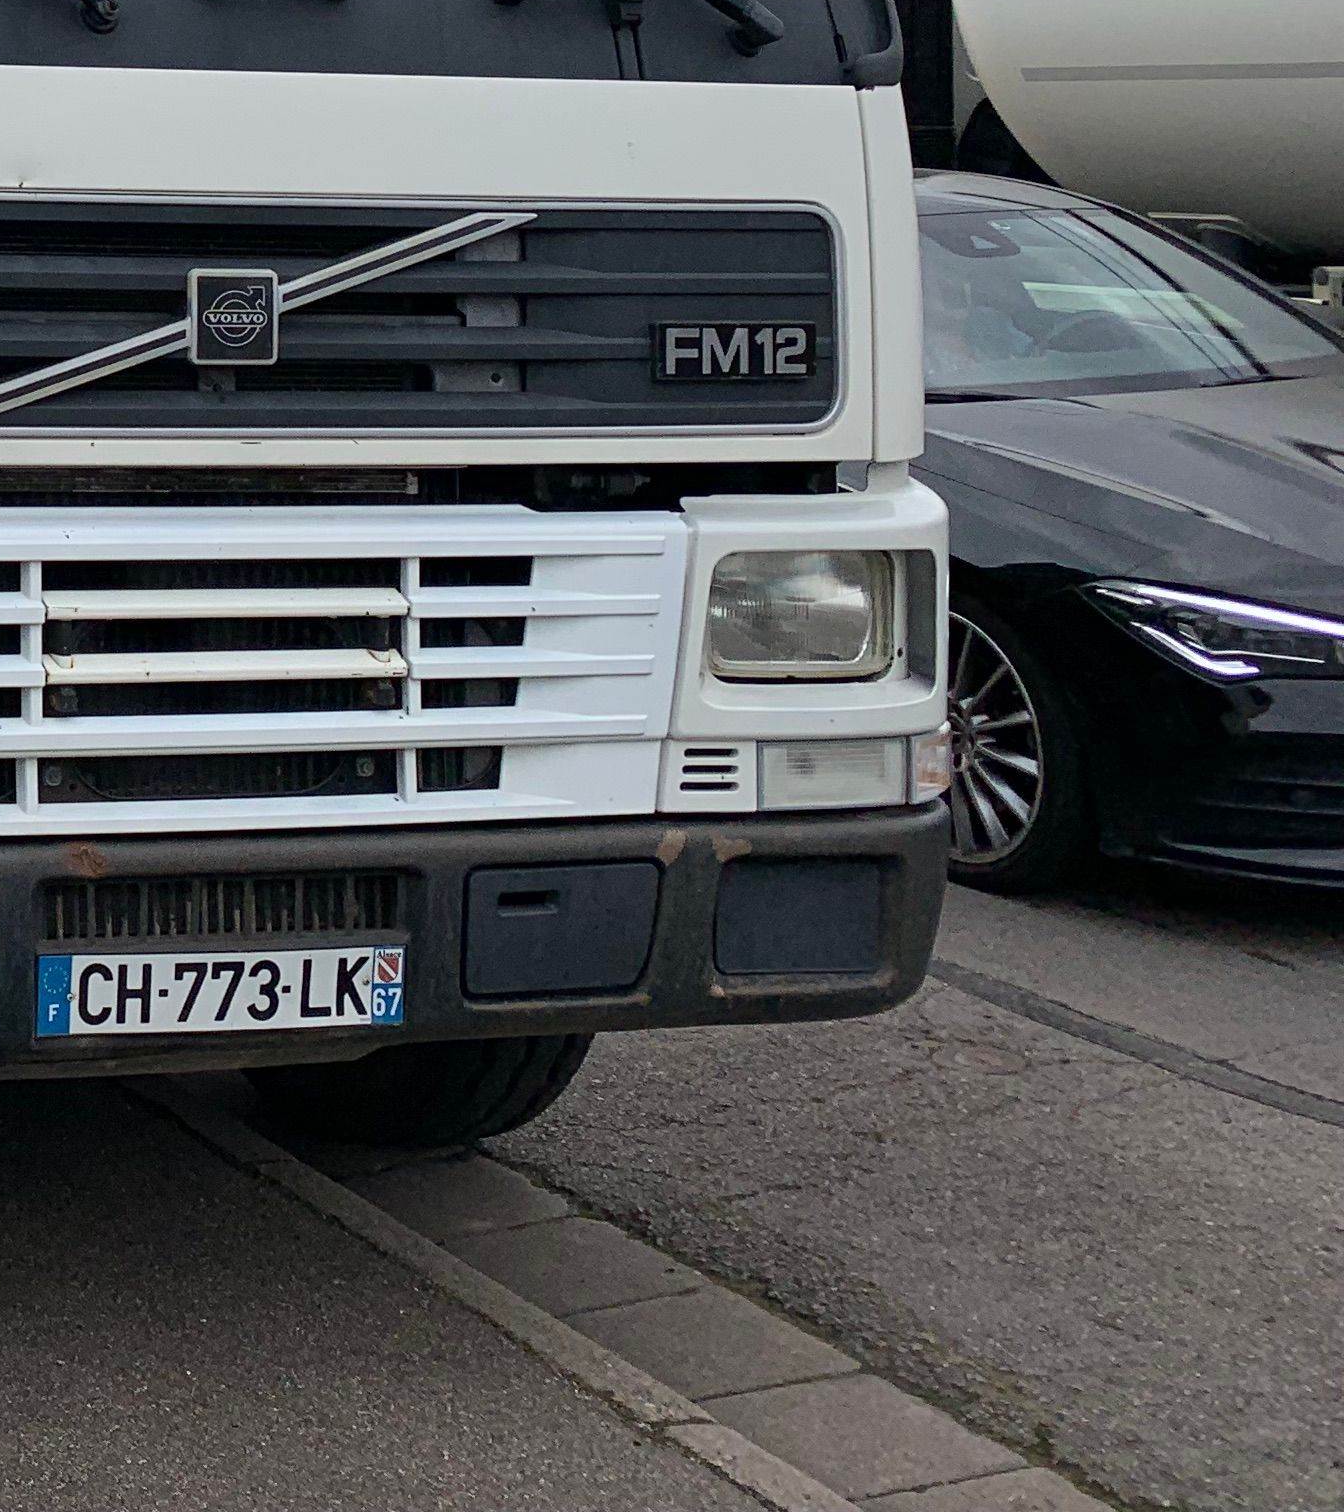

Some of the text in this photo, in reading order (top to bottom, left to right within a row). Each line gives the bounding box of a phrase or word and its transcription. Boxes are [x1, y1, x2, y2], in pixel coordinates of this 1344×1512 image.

[206, 313, 264, 324] VOLVO
[665, 327, 808, 375] FM12
[48, 956, 370, 1026] F CH-773-LK
[372, 987, 402, 1017] 67
